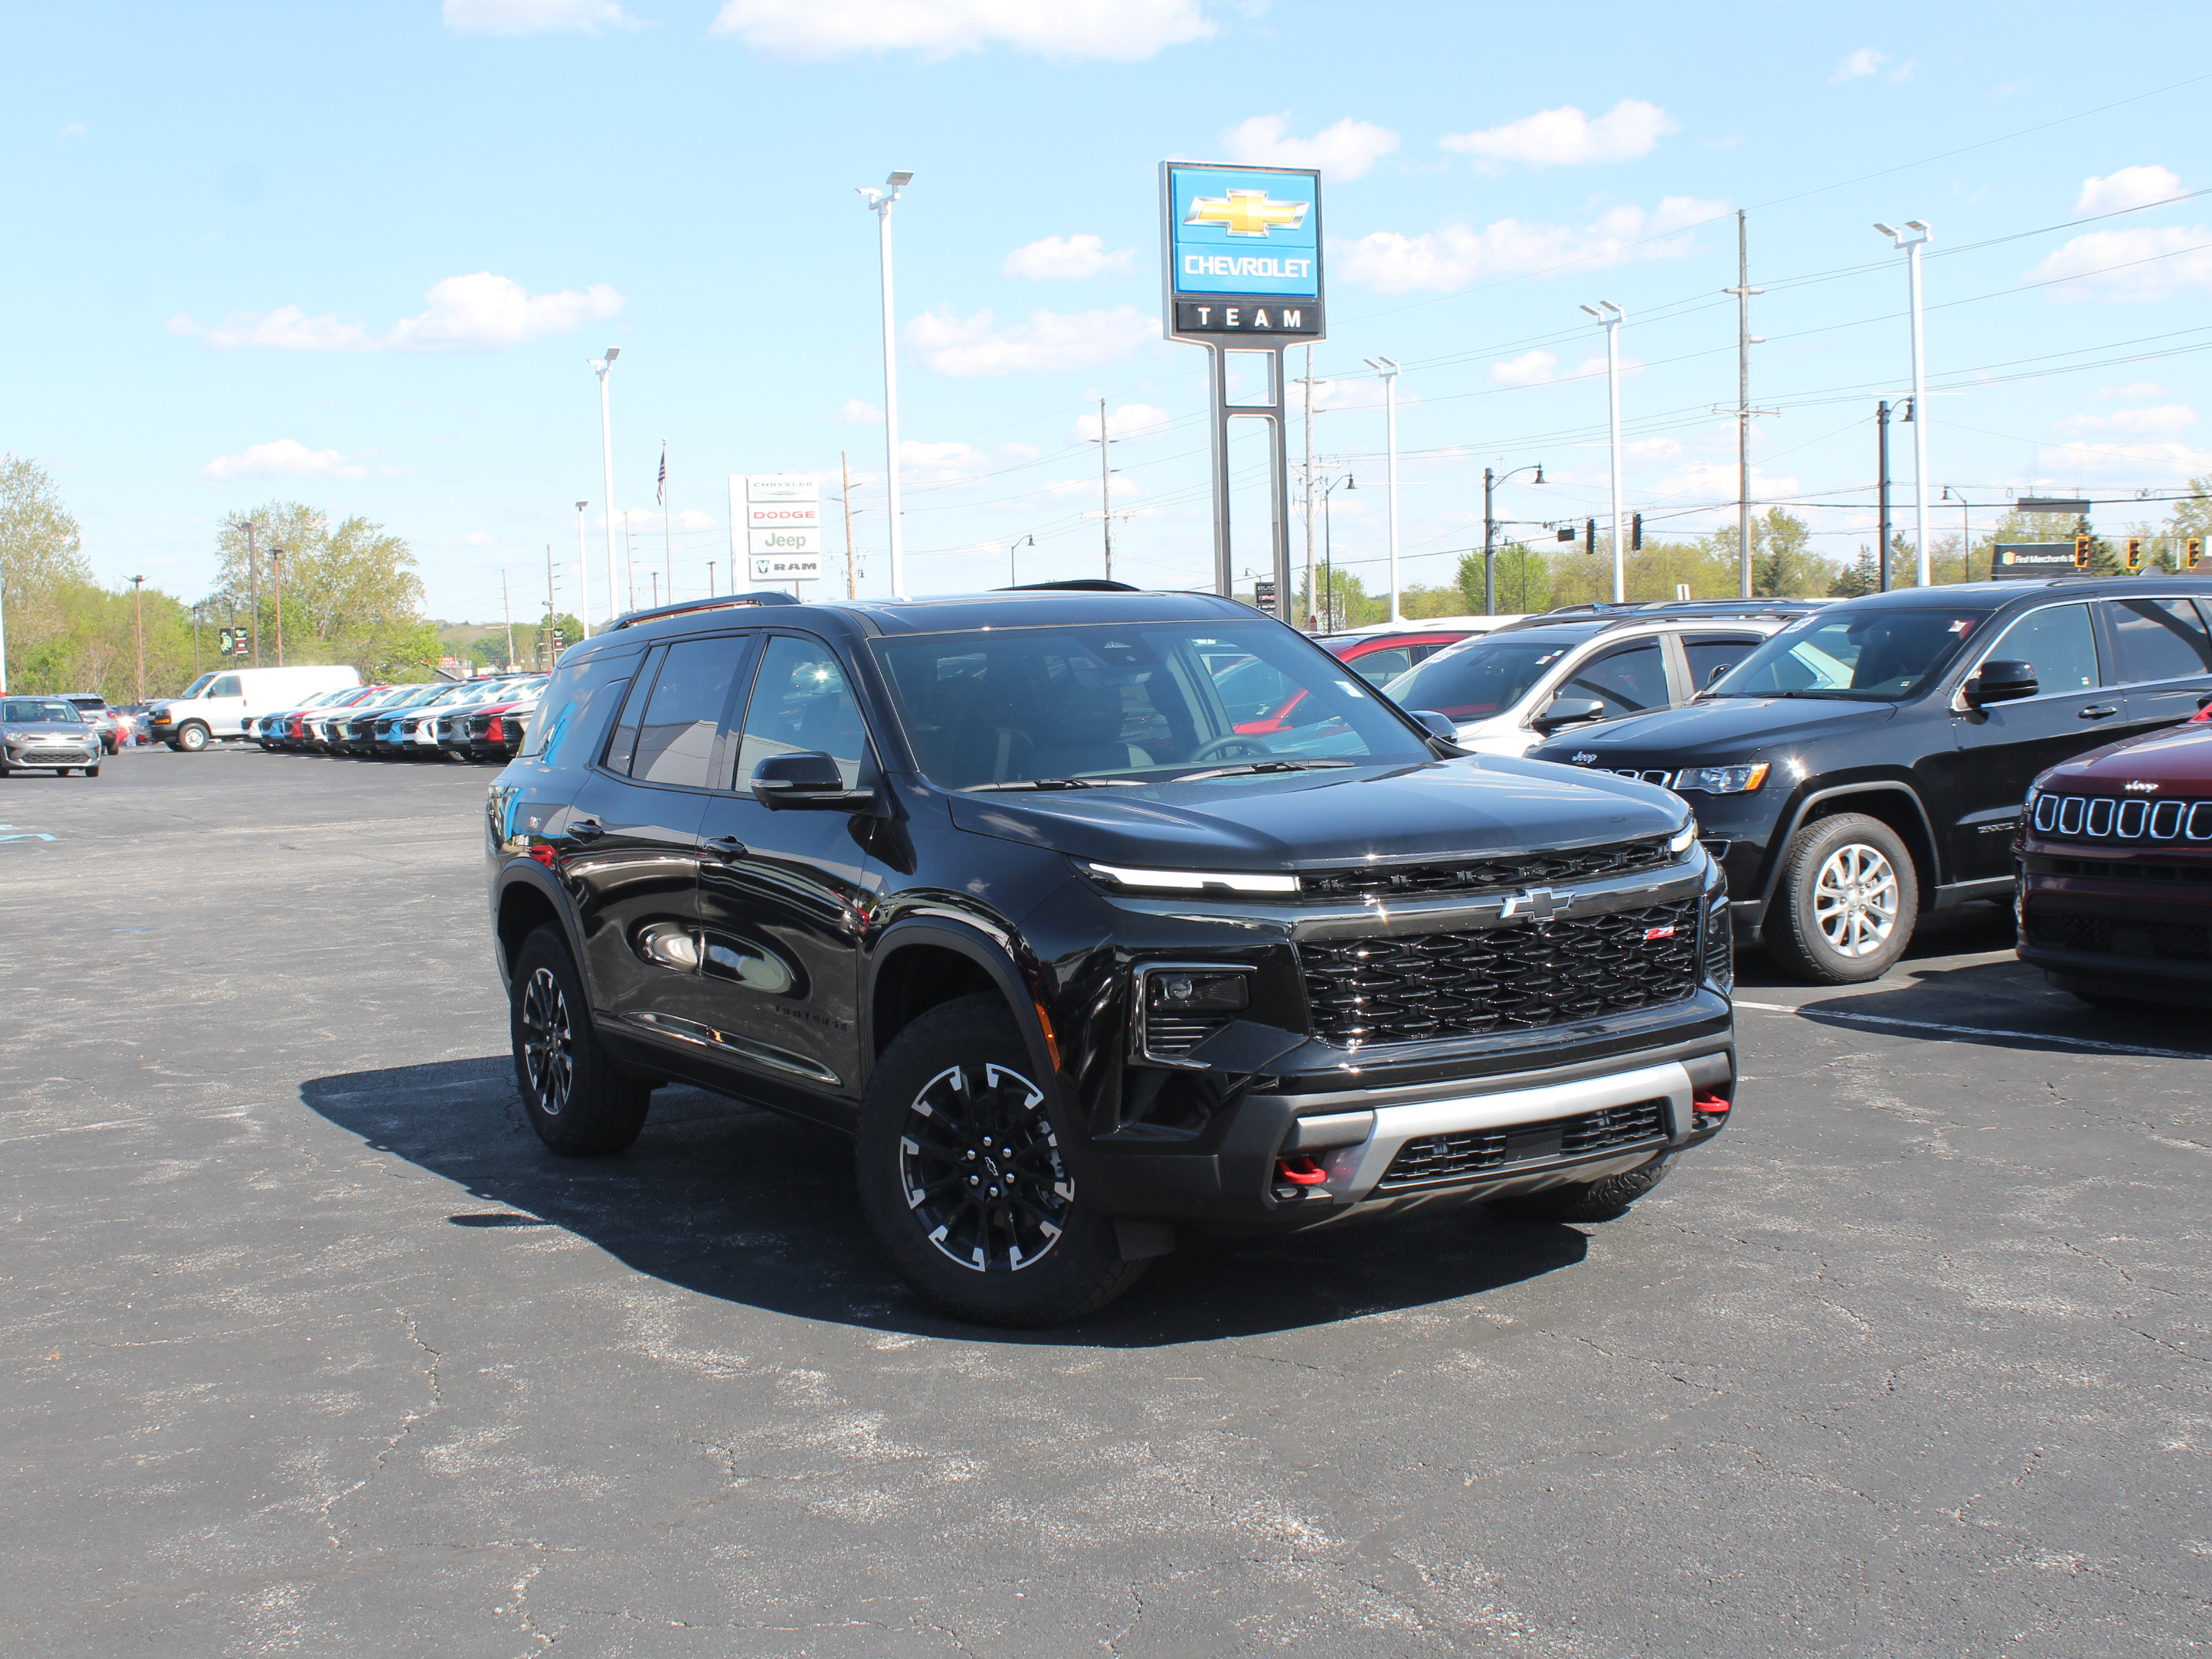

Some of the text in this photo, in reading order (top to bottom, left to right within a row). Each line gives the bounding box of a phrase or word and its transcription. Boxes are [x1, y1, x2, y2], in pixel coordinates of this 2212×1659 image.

[1184, 255, 1311, 278] CHEVROLET
[1197, 307, 1301, 328] TEAM
[765, 532, 806, 549] Jeep
[774, 562, 817, 571] RAM
[1572, 751, 1597, 763] Jeep
[1642, 926, 1676, 940] Z71
